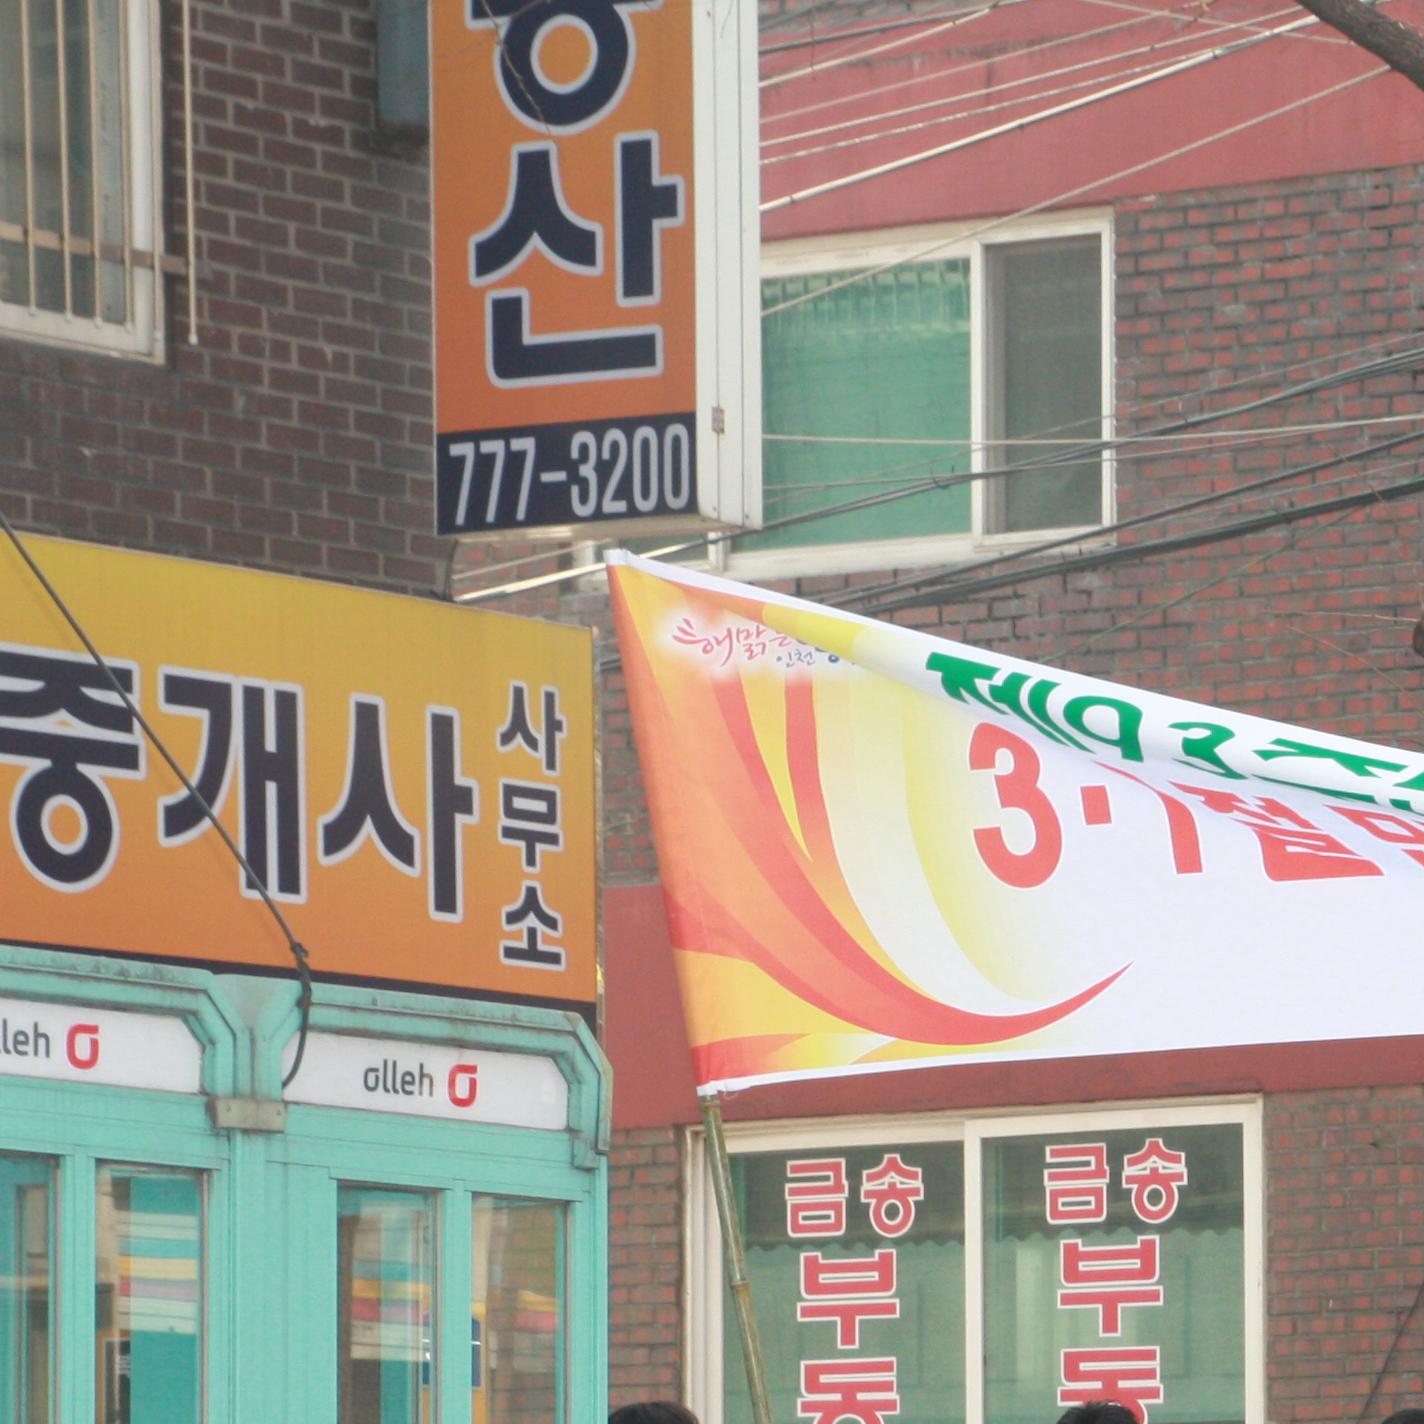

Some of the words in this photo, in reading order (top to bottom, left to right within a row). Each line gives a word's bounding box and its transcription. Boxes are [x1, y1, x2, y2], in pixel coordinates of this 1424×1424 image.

[449, 423, 690, 527] 777-3200
[0, 643, 478, 922] 중개사
[497, 681, 566, 971] 사무소
[0, 1017, 50, 1058] leh
[362, 1058, 434, 1099] olleh
[785, 1153, 924, 1239] 금송
[1043, 1137, 1188, 1226] 금송
